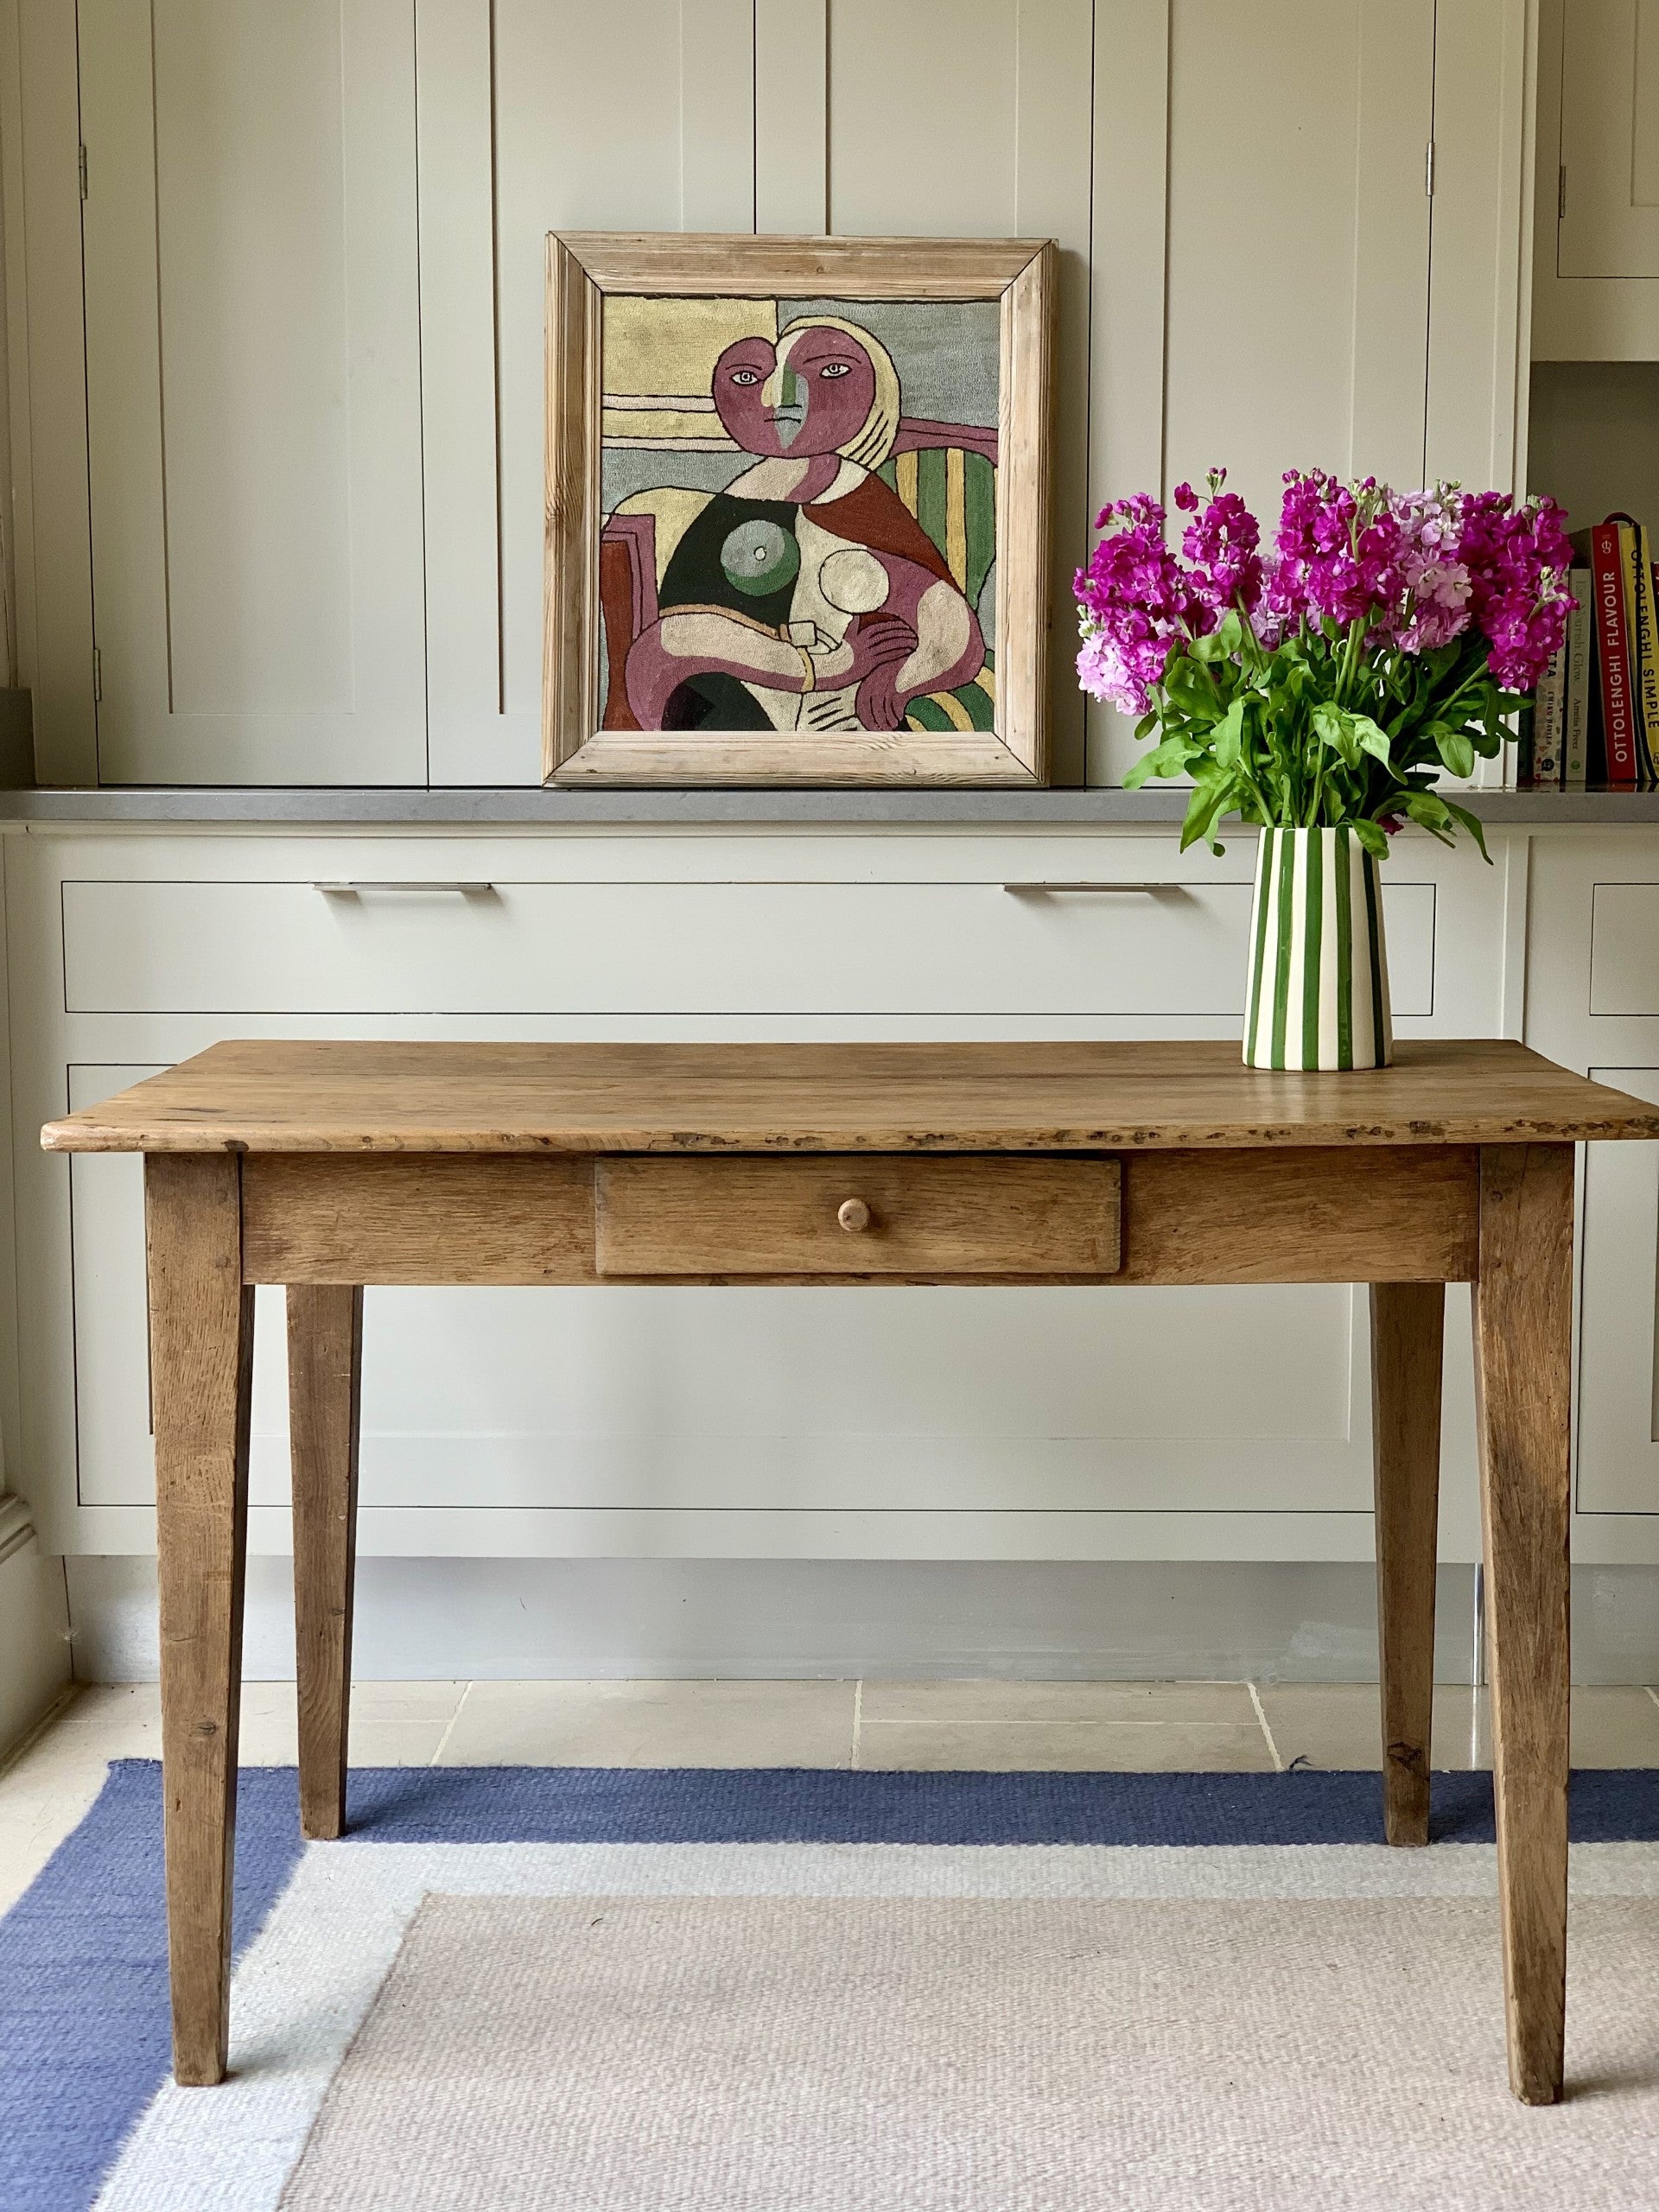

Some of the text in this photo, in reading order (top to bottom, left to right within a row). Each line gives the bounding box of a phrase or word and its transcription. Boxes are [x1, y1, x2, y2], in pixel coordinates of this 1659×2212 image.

[1603, 571, 1628, 762] OTTOLENGHI FLAVOUR
[1573, 698, 1581, 727] Amelia
[1643, 668, 1659, 728] SIMPLE
